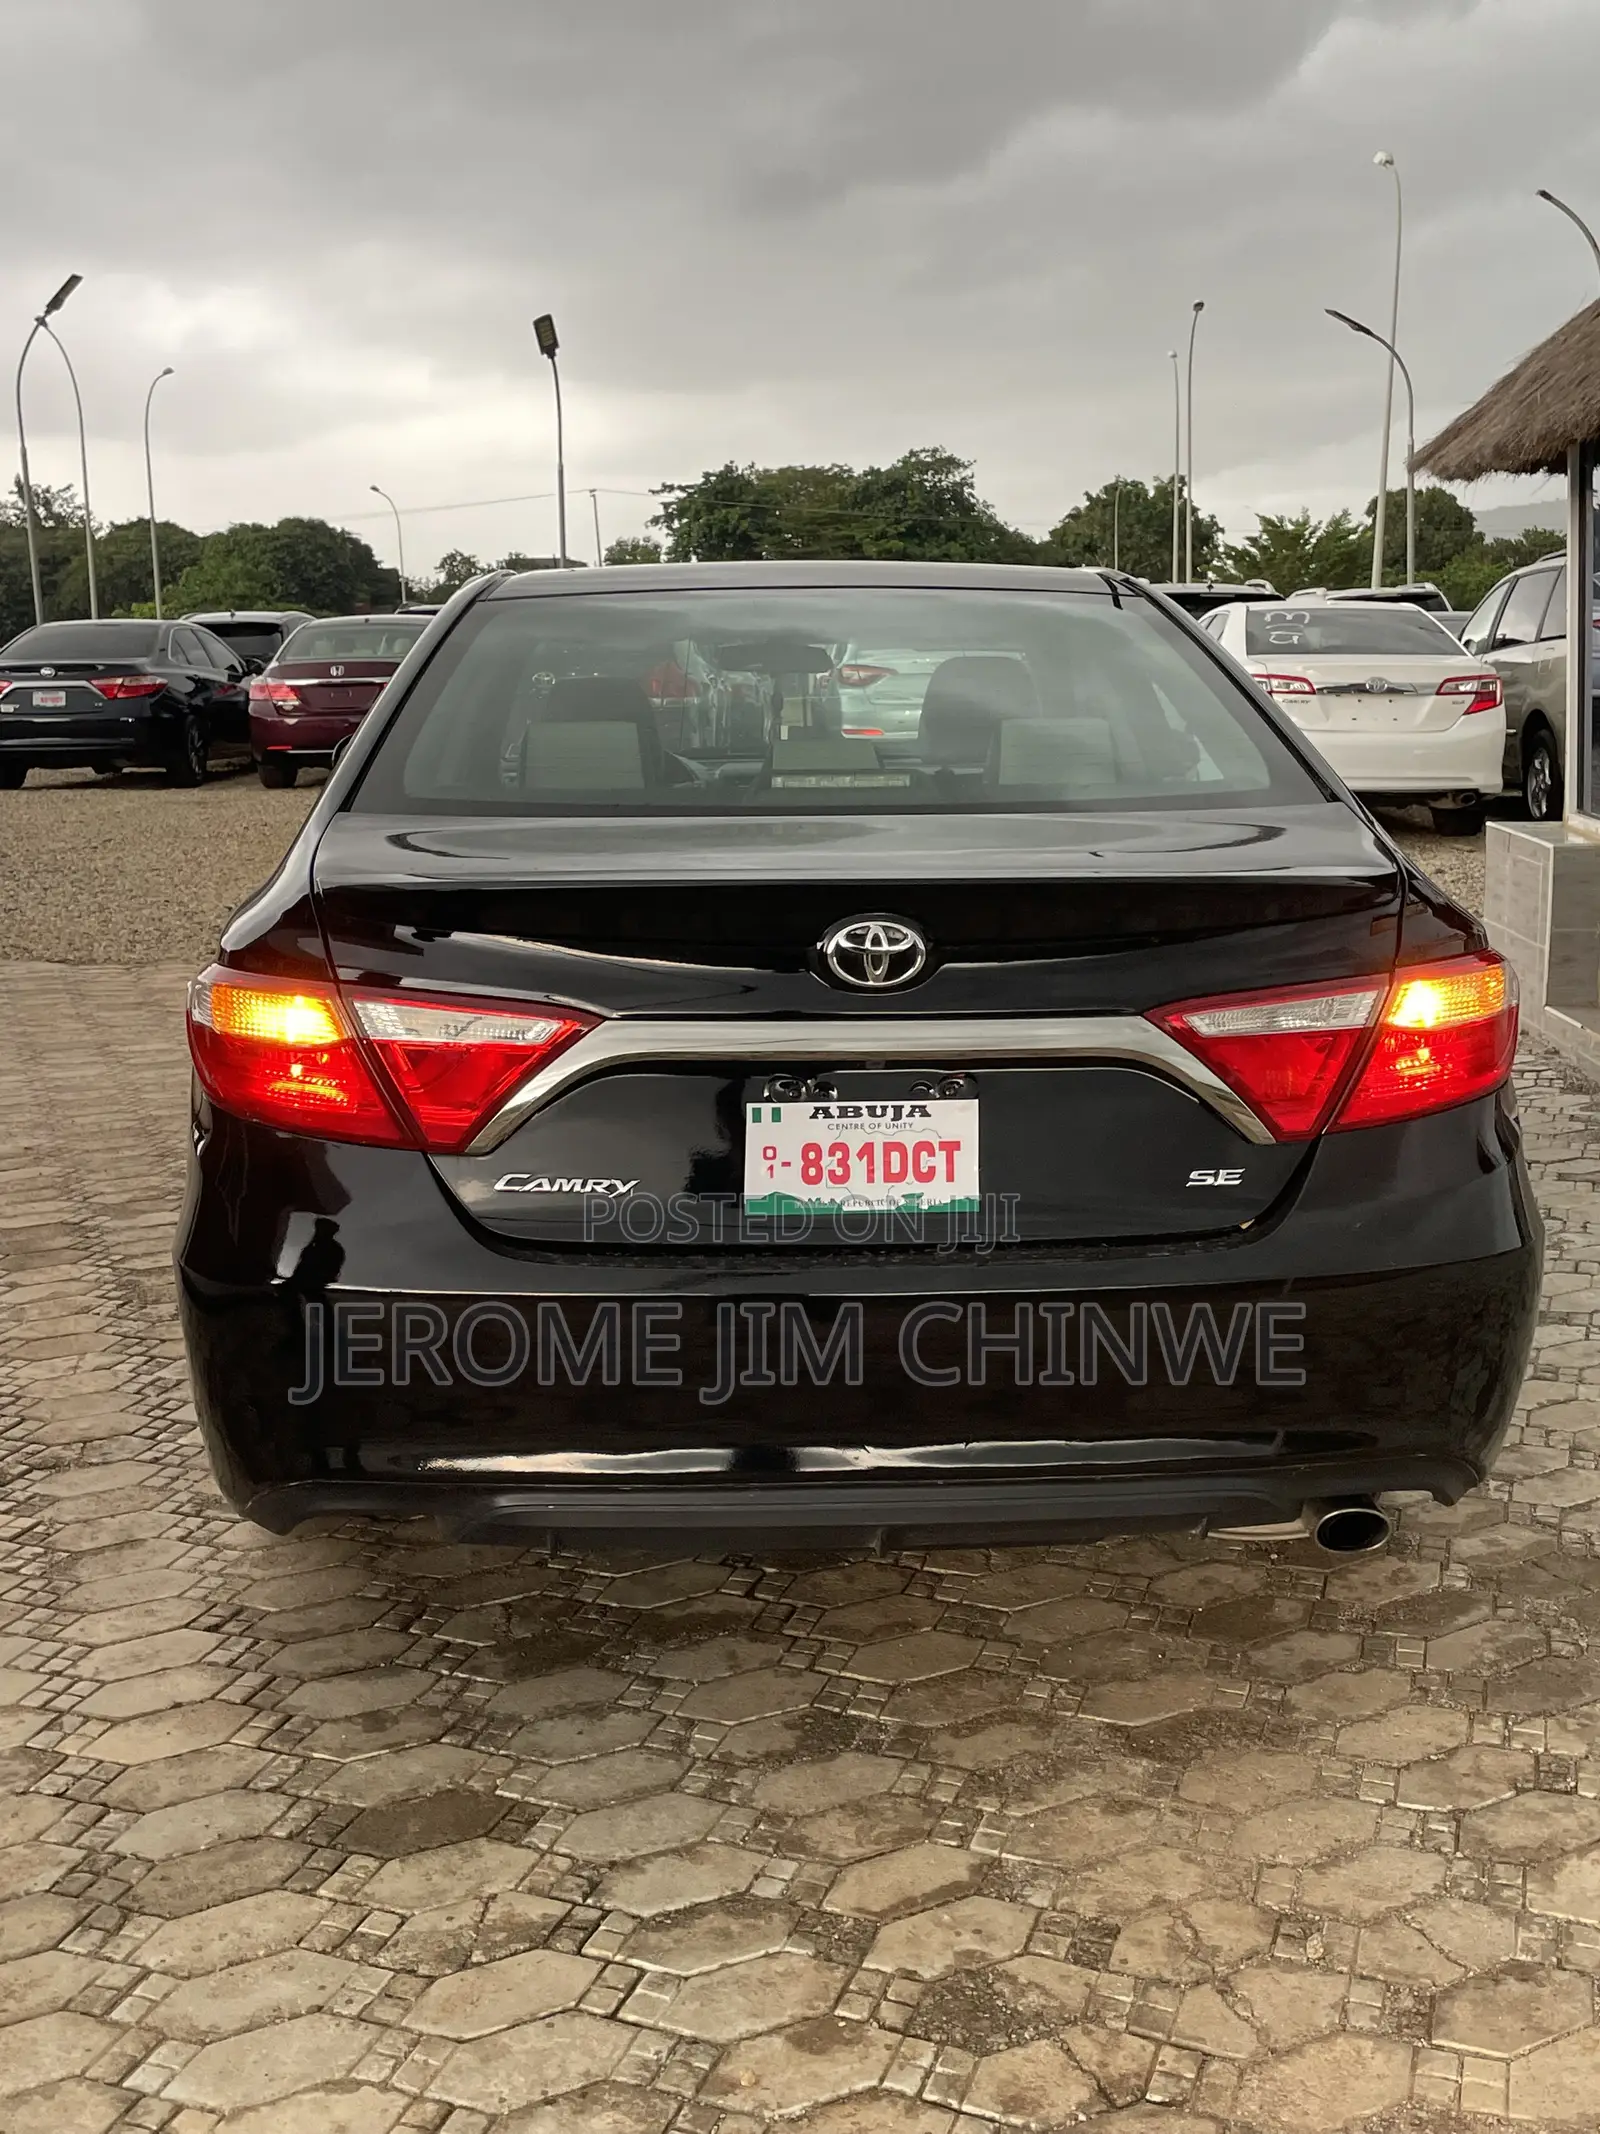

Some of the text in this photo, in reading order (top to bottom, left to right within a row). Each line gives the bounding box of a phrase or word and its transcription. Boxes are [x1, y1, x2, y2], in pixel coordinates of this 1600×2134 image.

[808, 1104, 932, 1122] ABUJA
[827, 1122, 914, 1131] CENTRE OF UNITY
[493, 1172, 641, 1198] CAMRY
[1185, 1168, 1246, 1187] SE
